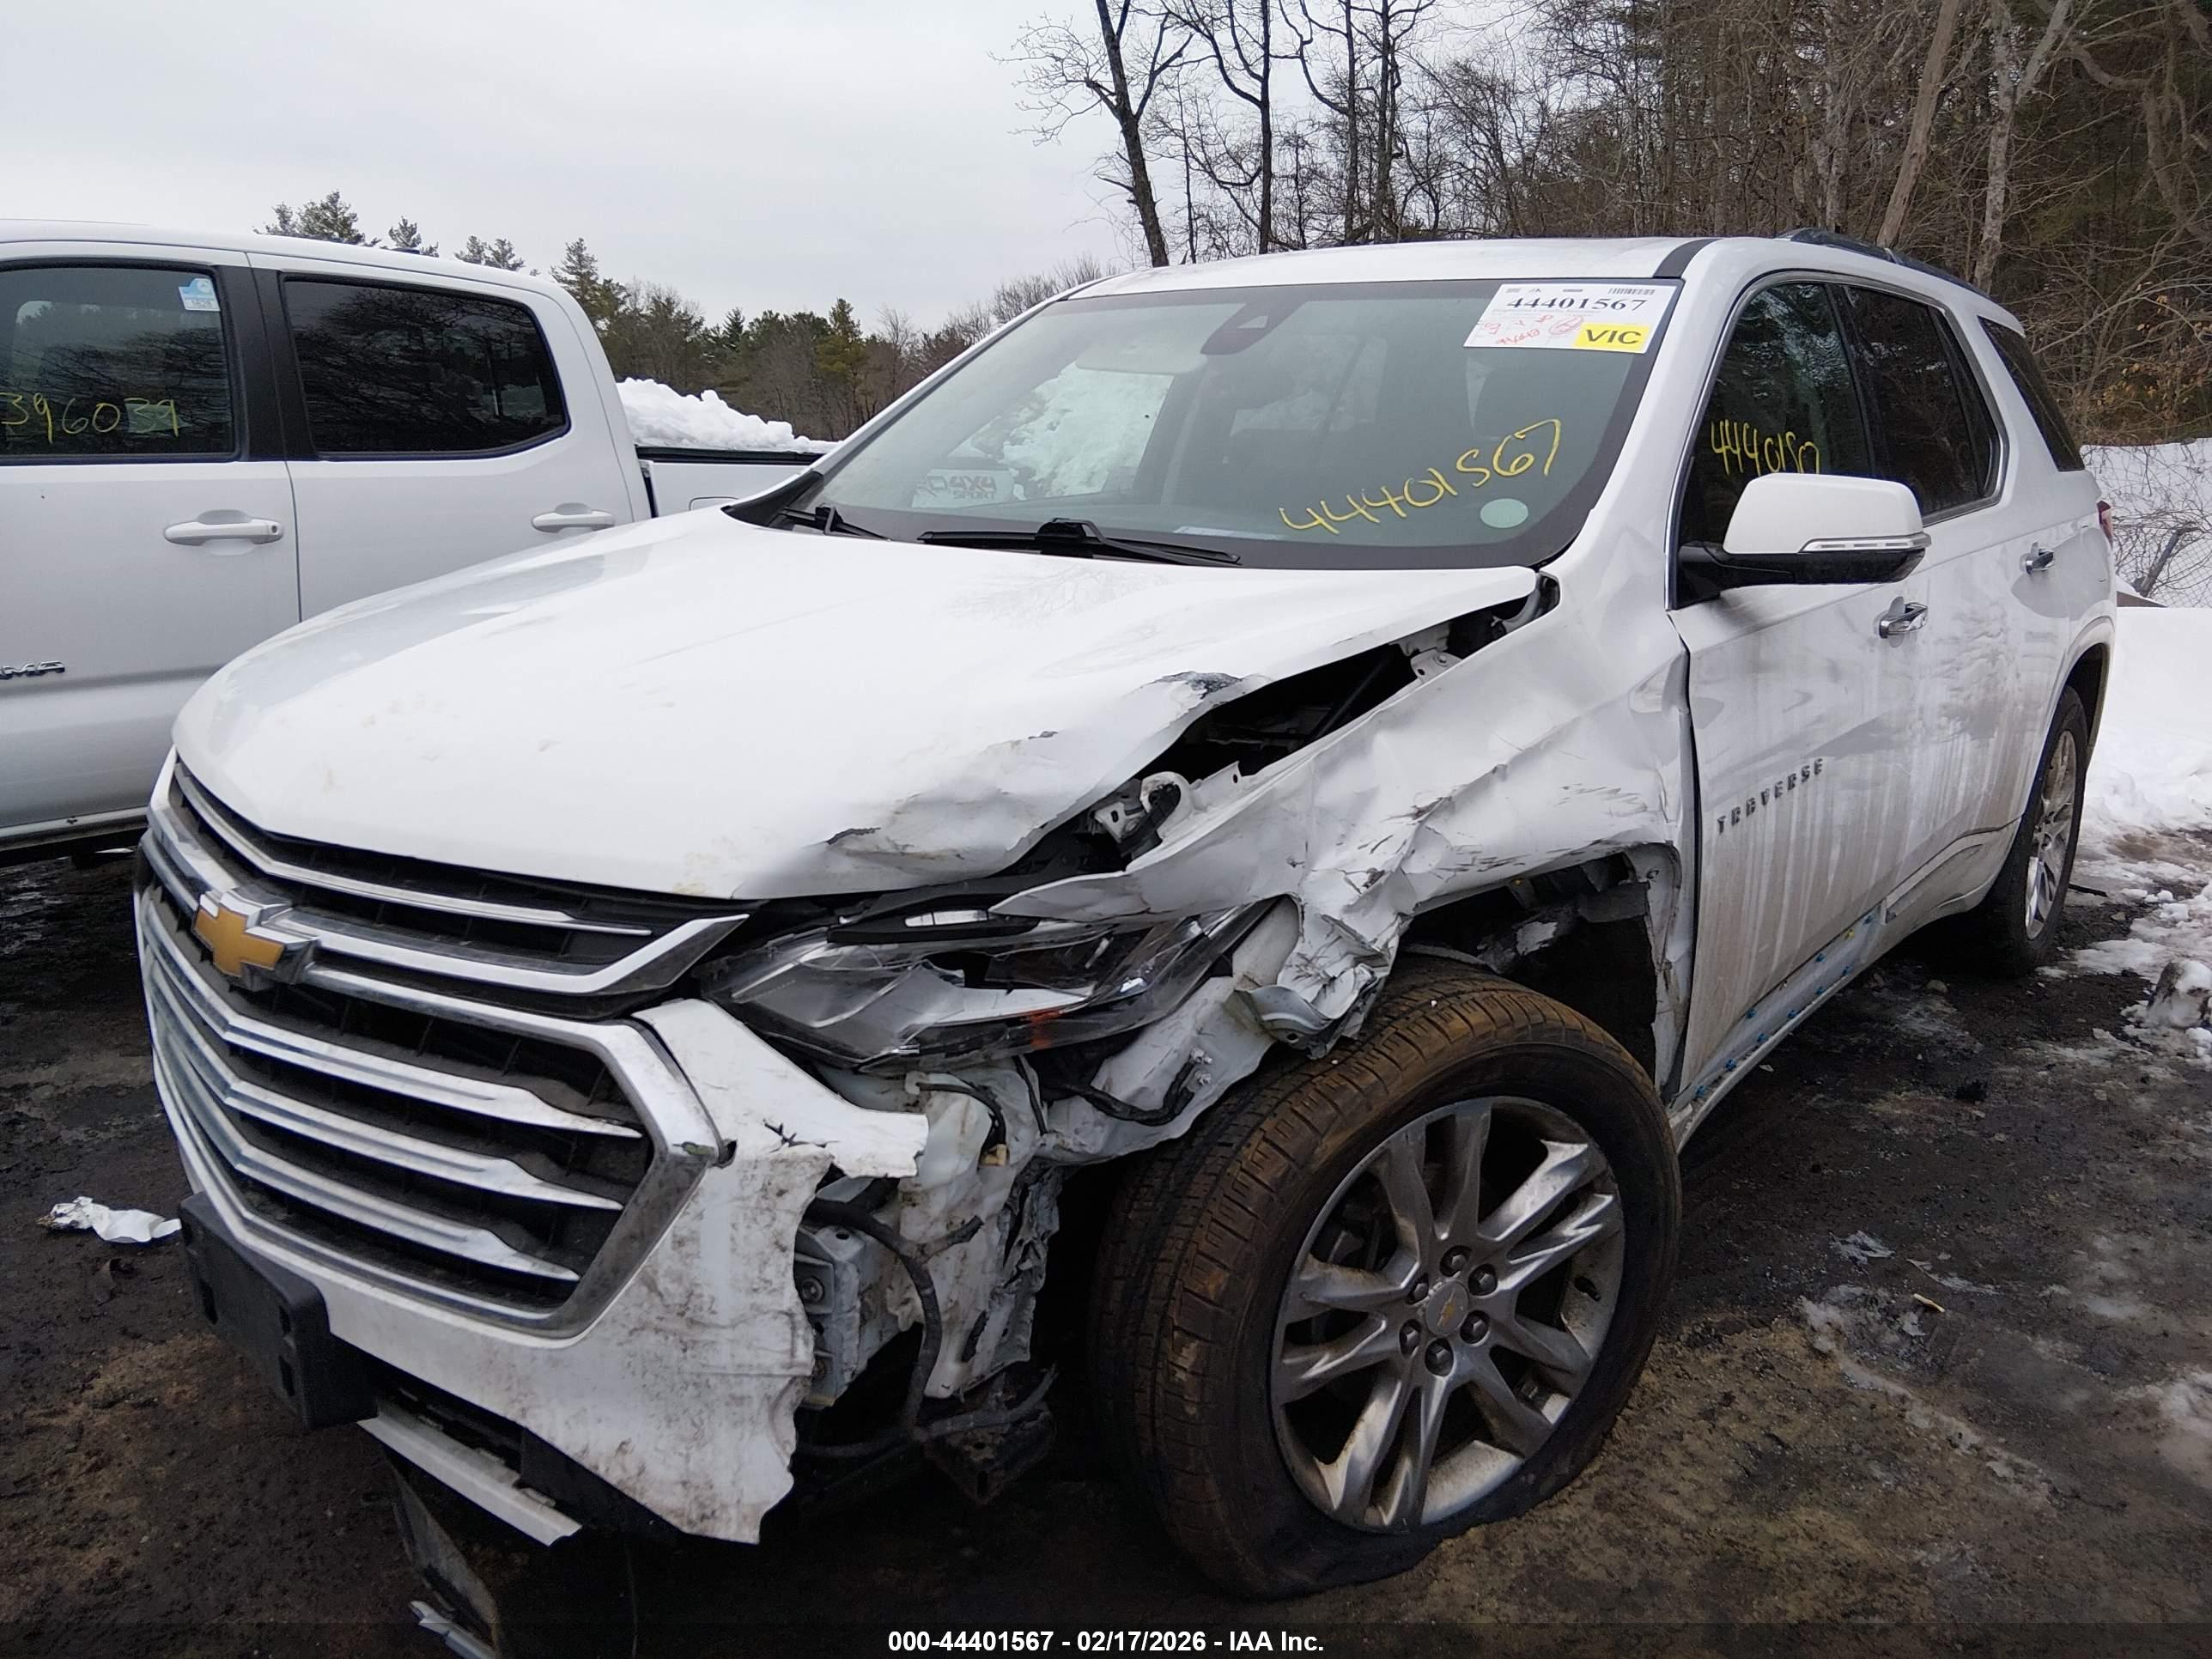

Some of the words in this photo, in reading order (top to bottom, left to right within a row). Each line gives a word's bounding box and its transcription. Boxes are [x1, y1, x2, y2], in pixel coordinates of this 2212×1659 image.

[1507, 297, 1650, 311] 44401567
[1585, 329, 1643, 344] VIC
[1278, 418, 1561, 535] 44401567
[1717, 758, 1823, 835] TRAVERSE
